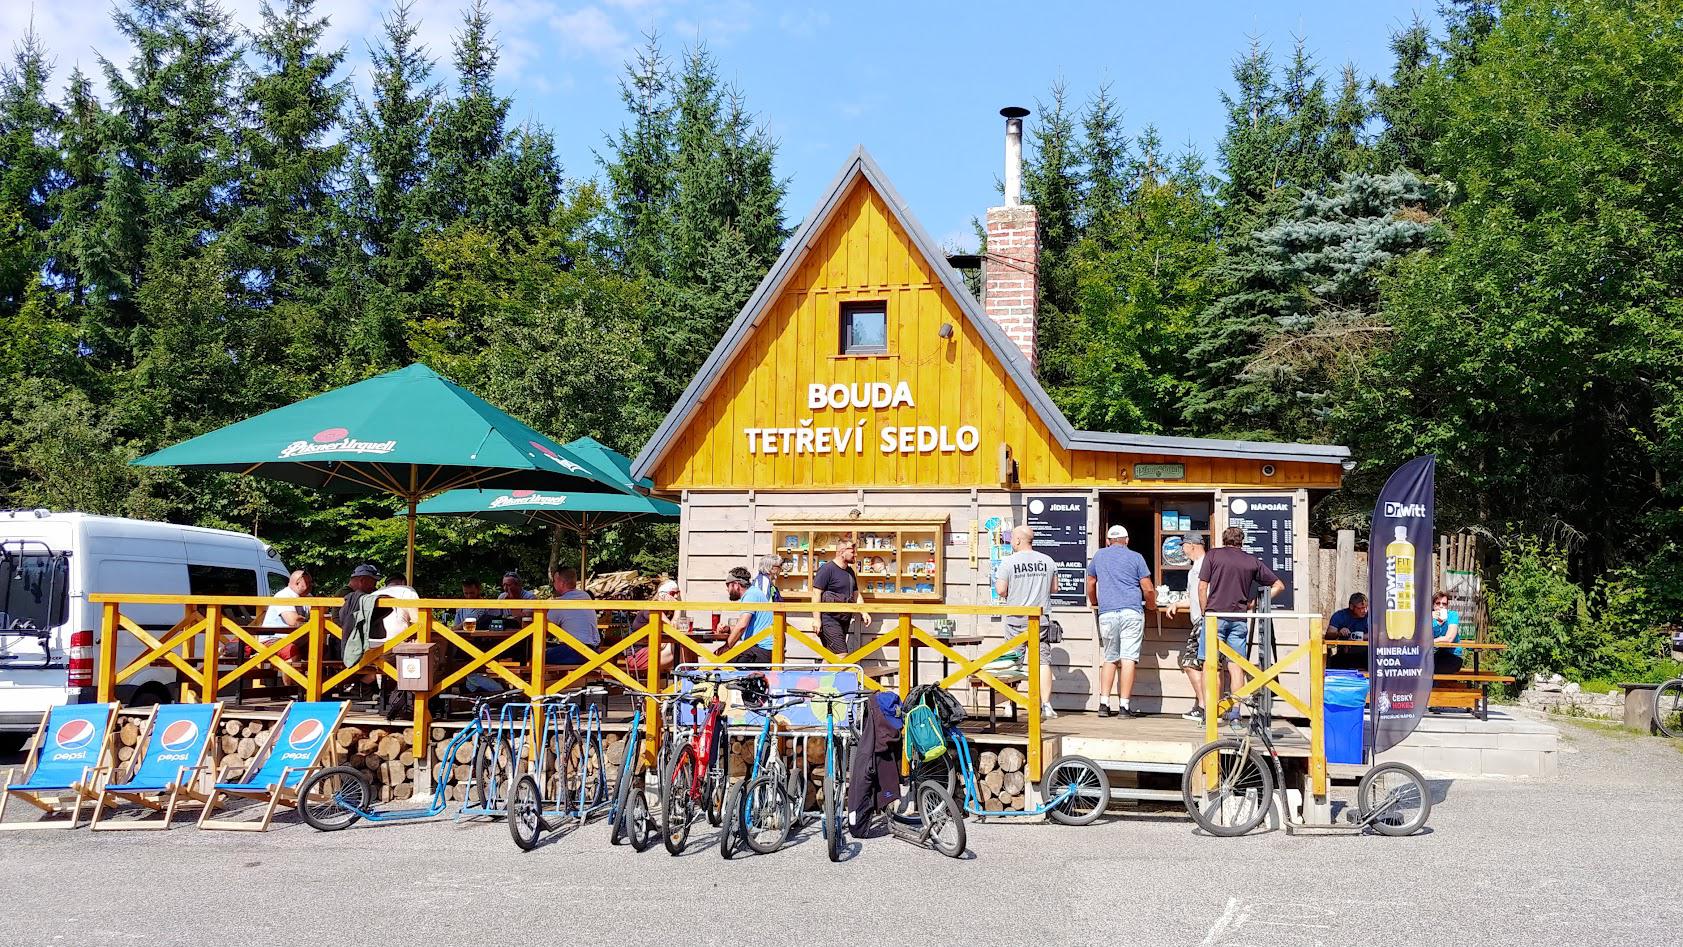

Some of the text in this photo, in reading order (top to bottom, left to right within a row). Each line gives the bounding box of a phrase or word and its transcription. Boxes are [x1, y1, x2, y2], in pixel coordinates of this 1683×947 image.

[808, 381, 915, 410] BOUDA
[743, 418, 980, 454] TETŘEVÍ SEDLO
[278, 438, 397, 459] Pilsner Urquell
[1049, 503, 1080, 512] JÍDELÁK
[1251, 503, 1288, 511] NÁPOJÁK
[1385, 501, 1426, 518] DrWitt
[1013, 560, 1047, 574] HASIČI
[1386, 556, 1396, 609] DrWitt
[1376, 646, 1419, 656] MINERÁLNÍ
[1376, 658, 1401, 667] VODA
[1376, 668, 1423, 677] S VITAMINY
[1392, 693, 1413, 702] ČESKÝ
[53, 751, 87, 761] pepsi
[156, 752, 189, 762] pepsi
[280, 750, 311, 761] pepsi
